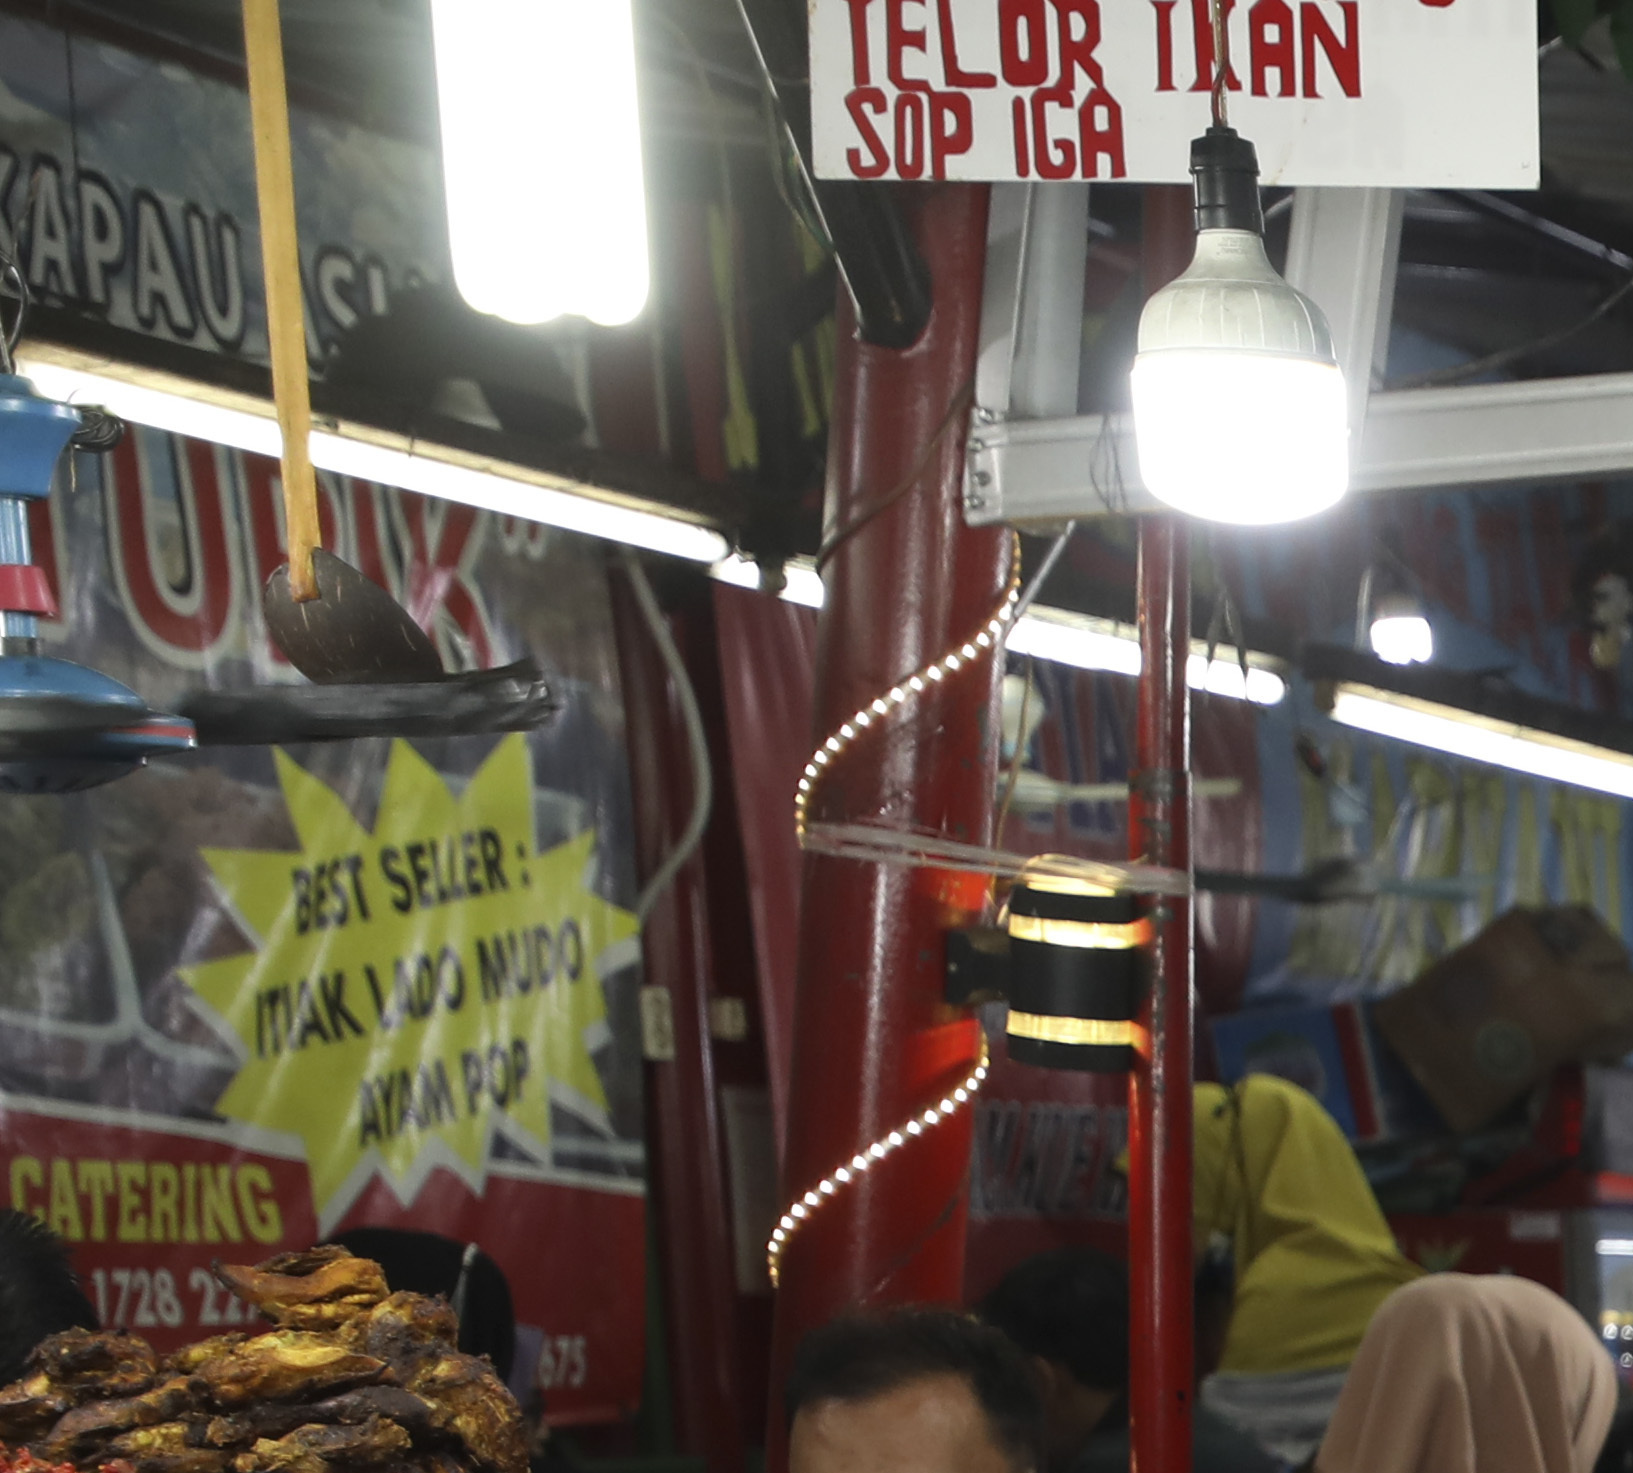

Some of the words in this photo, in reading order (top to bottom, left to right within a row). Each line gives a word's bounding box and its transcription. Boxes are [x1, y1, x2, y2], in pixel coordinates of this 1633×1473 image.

[849, 0, 1105, 92] TELOR
[1154, 0, 1362, 98] IKAN
[845, 87, 974, 180] SOP
[1013, 87, 1126, 179] IGA
[291, 855, 371, 935] BEST
[378, 826, 509, 914] SELLER
[255, 969, 367, 1061] ITIAK
[362, 945, 467, 1032] LADO
[475, 916, 585, 1004] MUDO
[358, 1057, 458, 1148] AYAM
[461, 1036, 531, 1118] POP
[8, 1155, 286, 1246] CATERING
